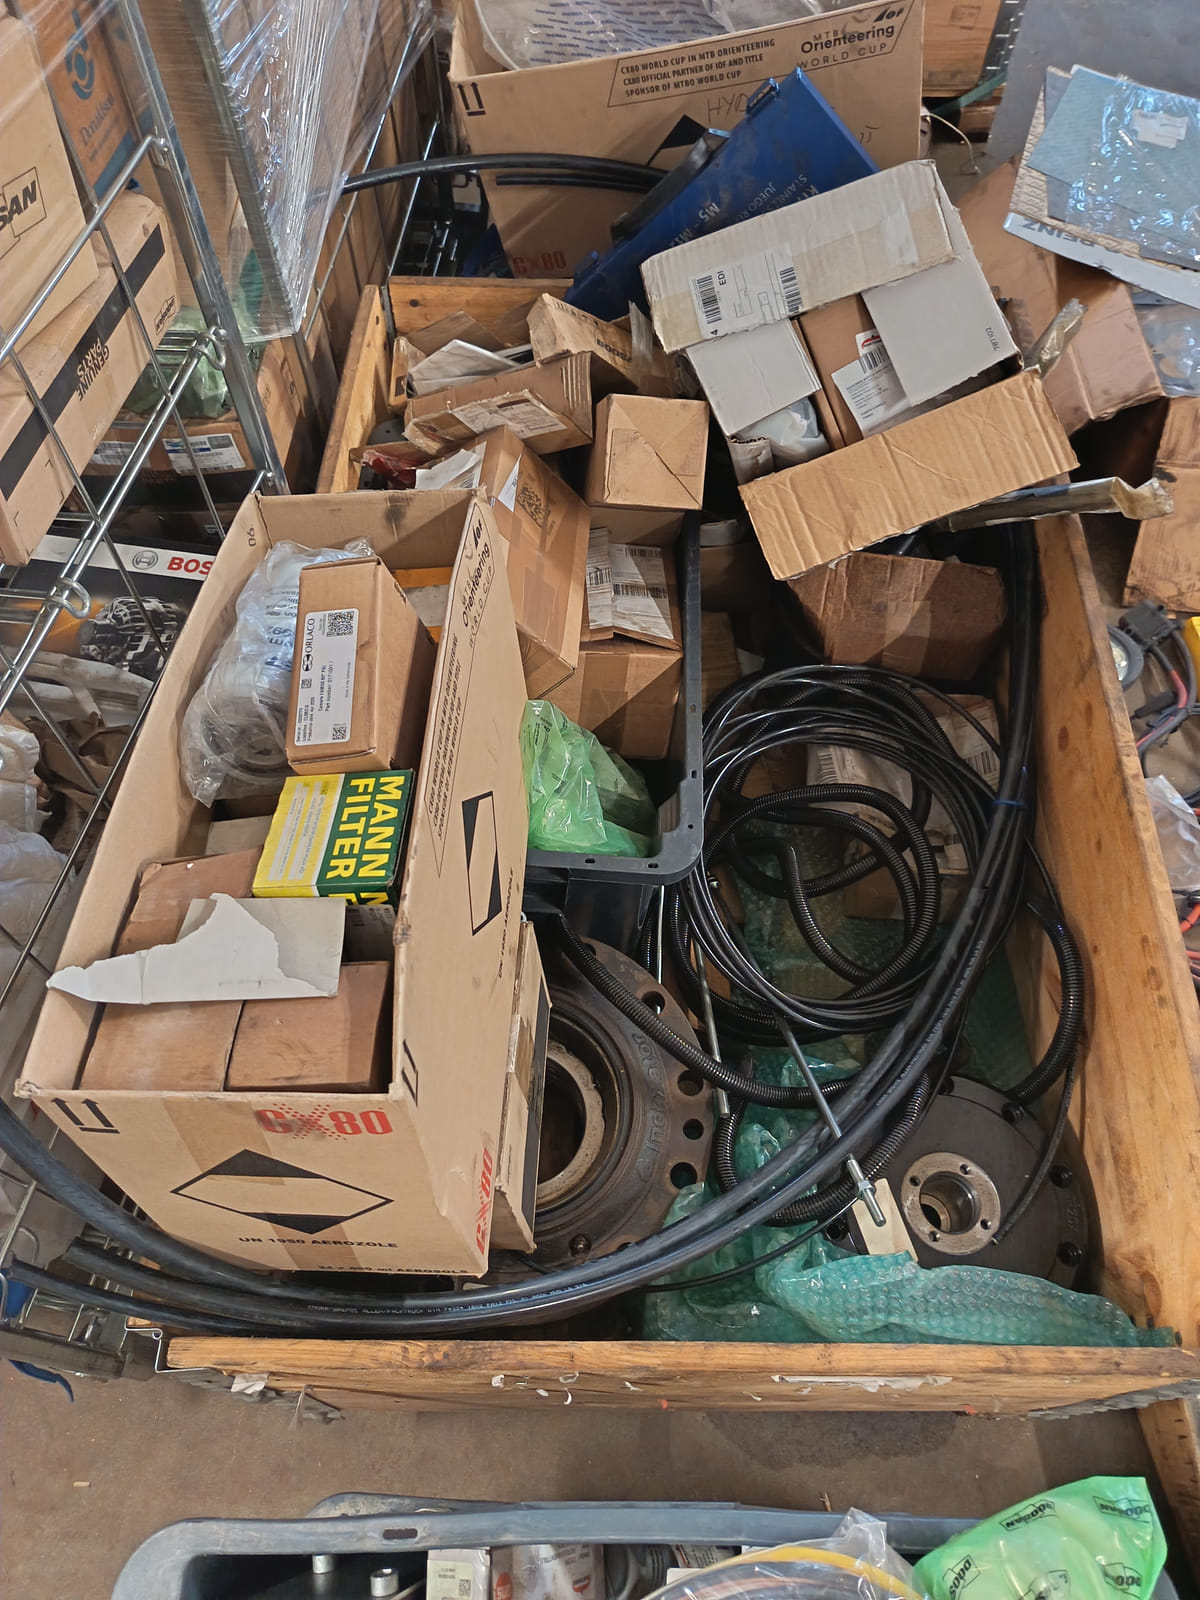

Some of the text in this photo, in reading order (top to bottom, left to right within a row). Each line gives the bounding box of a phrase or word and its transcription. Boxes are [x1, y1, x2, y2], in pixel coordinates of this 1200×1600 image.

[801, 25, 895, 54] Orienteering
[813, 29, 839, 41] MTB
[620, 38, 776, 75] CX80 WORLD CUP IN MTB ORIENTEERING
[623, 53, 764, 86] CX80 OFFICIAL PARTNER OF IOF AND TITLE
[797, 42, 887, 69] WORLD CUP
[625, 70, 742, 98] SPONSOR OF MTBO WORLD CUP
[698, 202, 720, 223] M5
[76, 345, 110, 402] GENUINE
[77, 337, 102, 378] PARTS
[462, 541, 490, 628] Orienteering
[482, 565, 492, 594] CUP
[305, 617, 316, 654] ORLACO
[432, 750, 441, 787] WORLD
[325, 777, 376, 880] FILTER
[357, 775, 405, 878] MANN
[254, 1103, 393, 1141] CX80
[475, 1147, 493, 1255] CX80
[311, 1239, 399, 1248] AEROZOLE
[1004, 1501, 1055, 1529] DOOSAN
